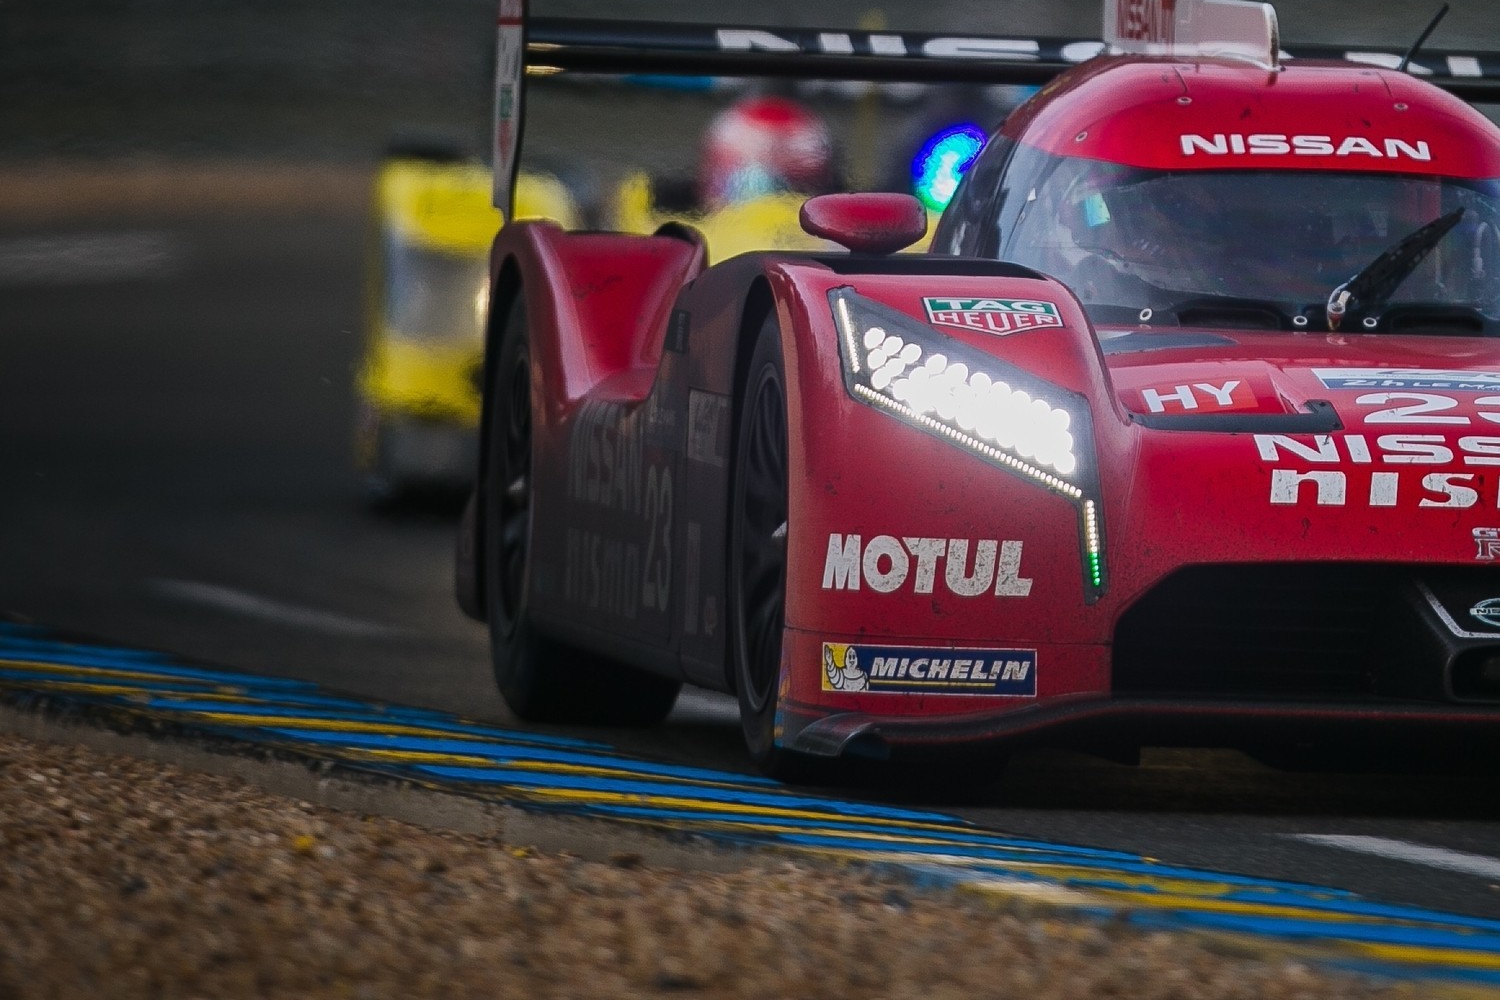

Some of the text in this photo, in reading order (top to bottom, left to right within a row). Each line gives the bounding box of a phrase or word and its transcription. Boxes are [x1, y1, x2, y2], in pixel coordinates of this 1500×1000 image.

[1180, 133, 1432, 161] NISSAN
[936, 299, 1044, 312] TAG
[937, 312, 1054, 331] HEUER
[1142, 380, 1243, 413] HY
[643, 464, 673, 612] 23
[822, 533, 1033, 597] MOTUL
[870, 656, 1031, 681] MICHELIN
